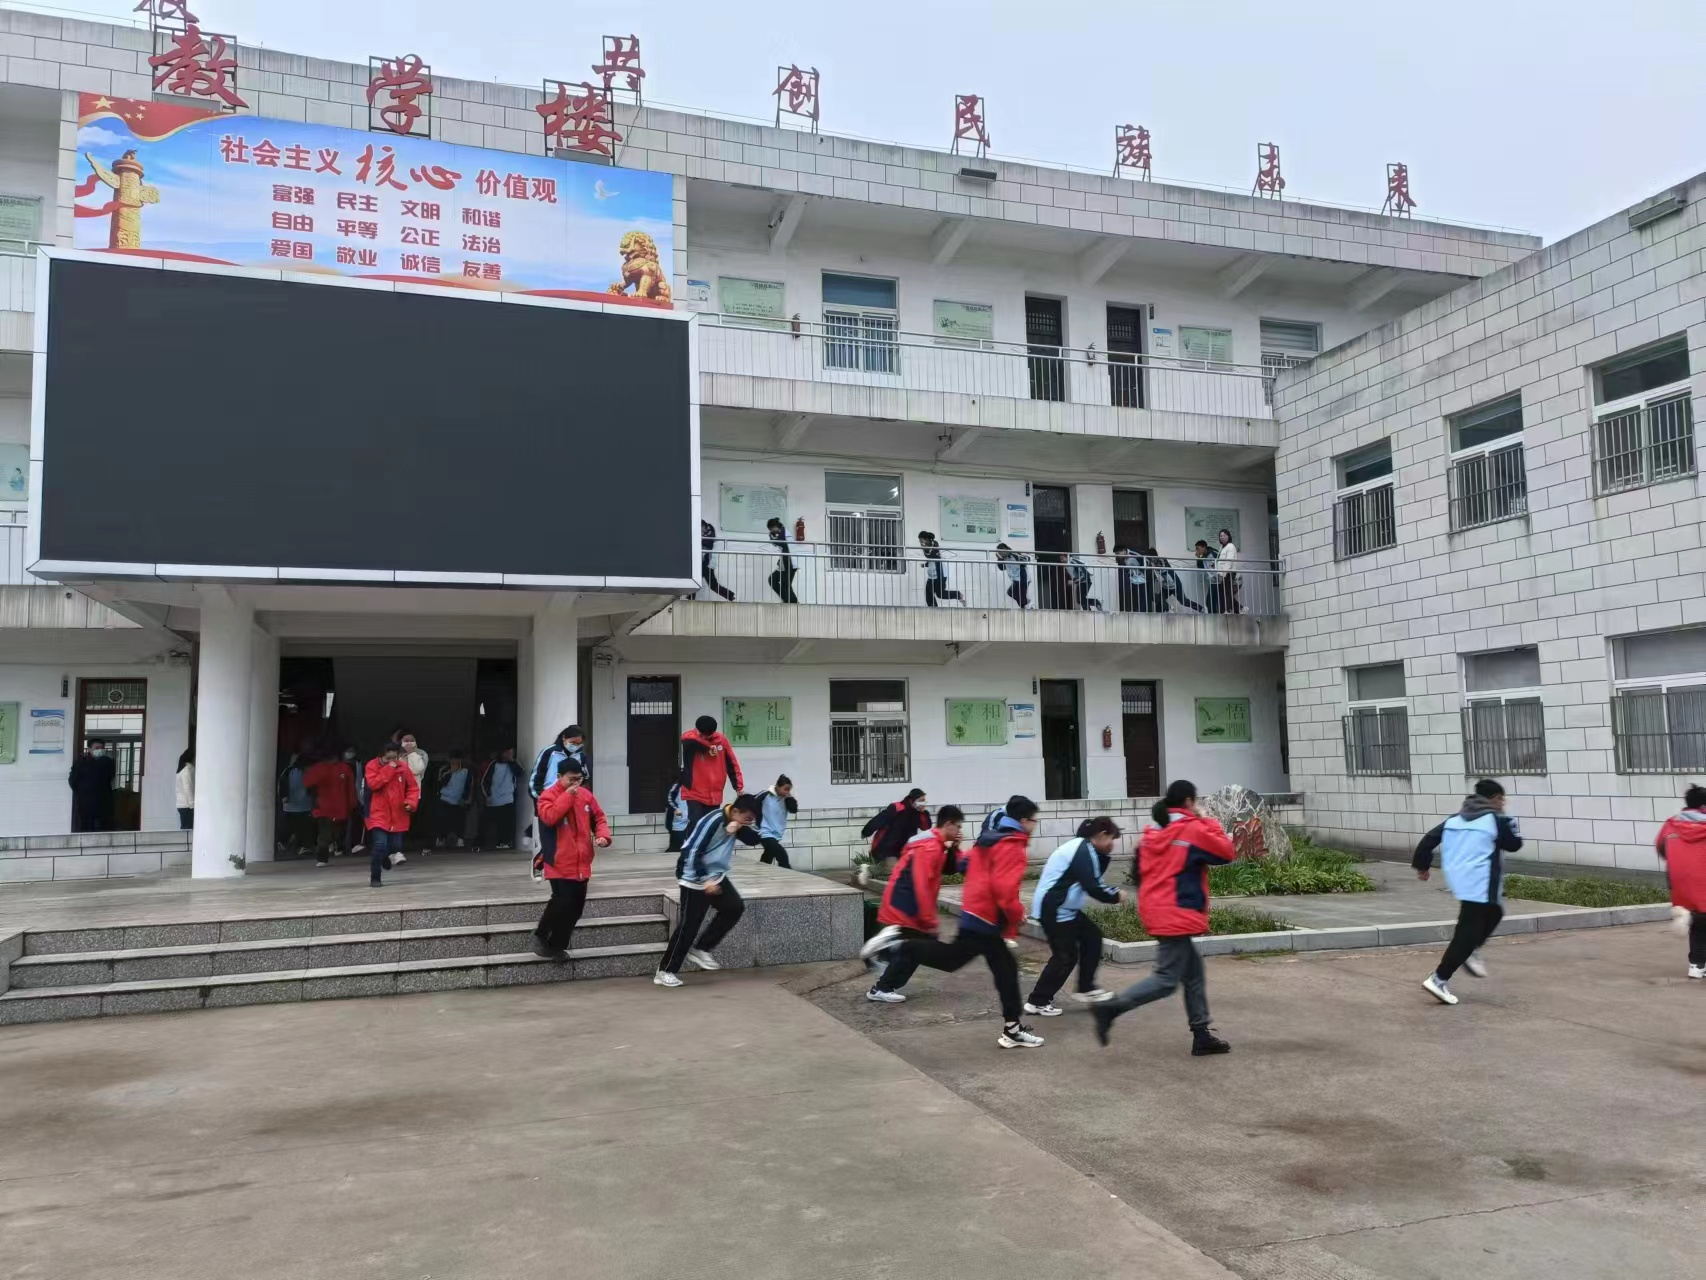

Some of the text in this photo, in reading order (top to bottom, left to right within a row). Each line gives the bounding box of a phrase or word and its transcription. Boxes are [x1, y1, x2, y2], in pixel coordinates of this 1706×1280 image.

[220, 135, 557, 203] 社会主义 核心 价值观
[272, 184, 501, 228] 富强 民主 文明 和谐
[272, 211, 501, 254] 自由 平等 公正 法治
[271, 239, 501, 280] 爱国 敬业 诚信 友善
[767, 701, 785, 721] 礼
[982, 703, 1001, 721] 和
